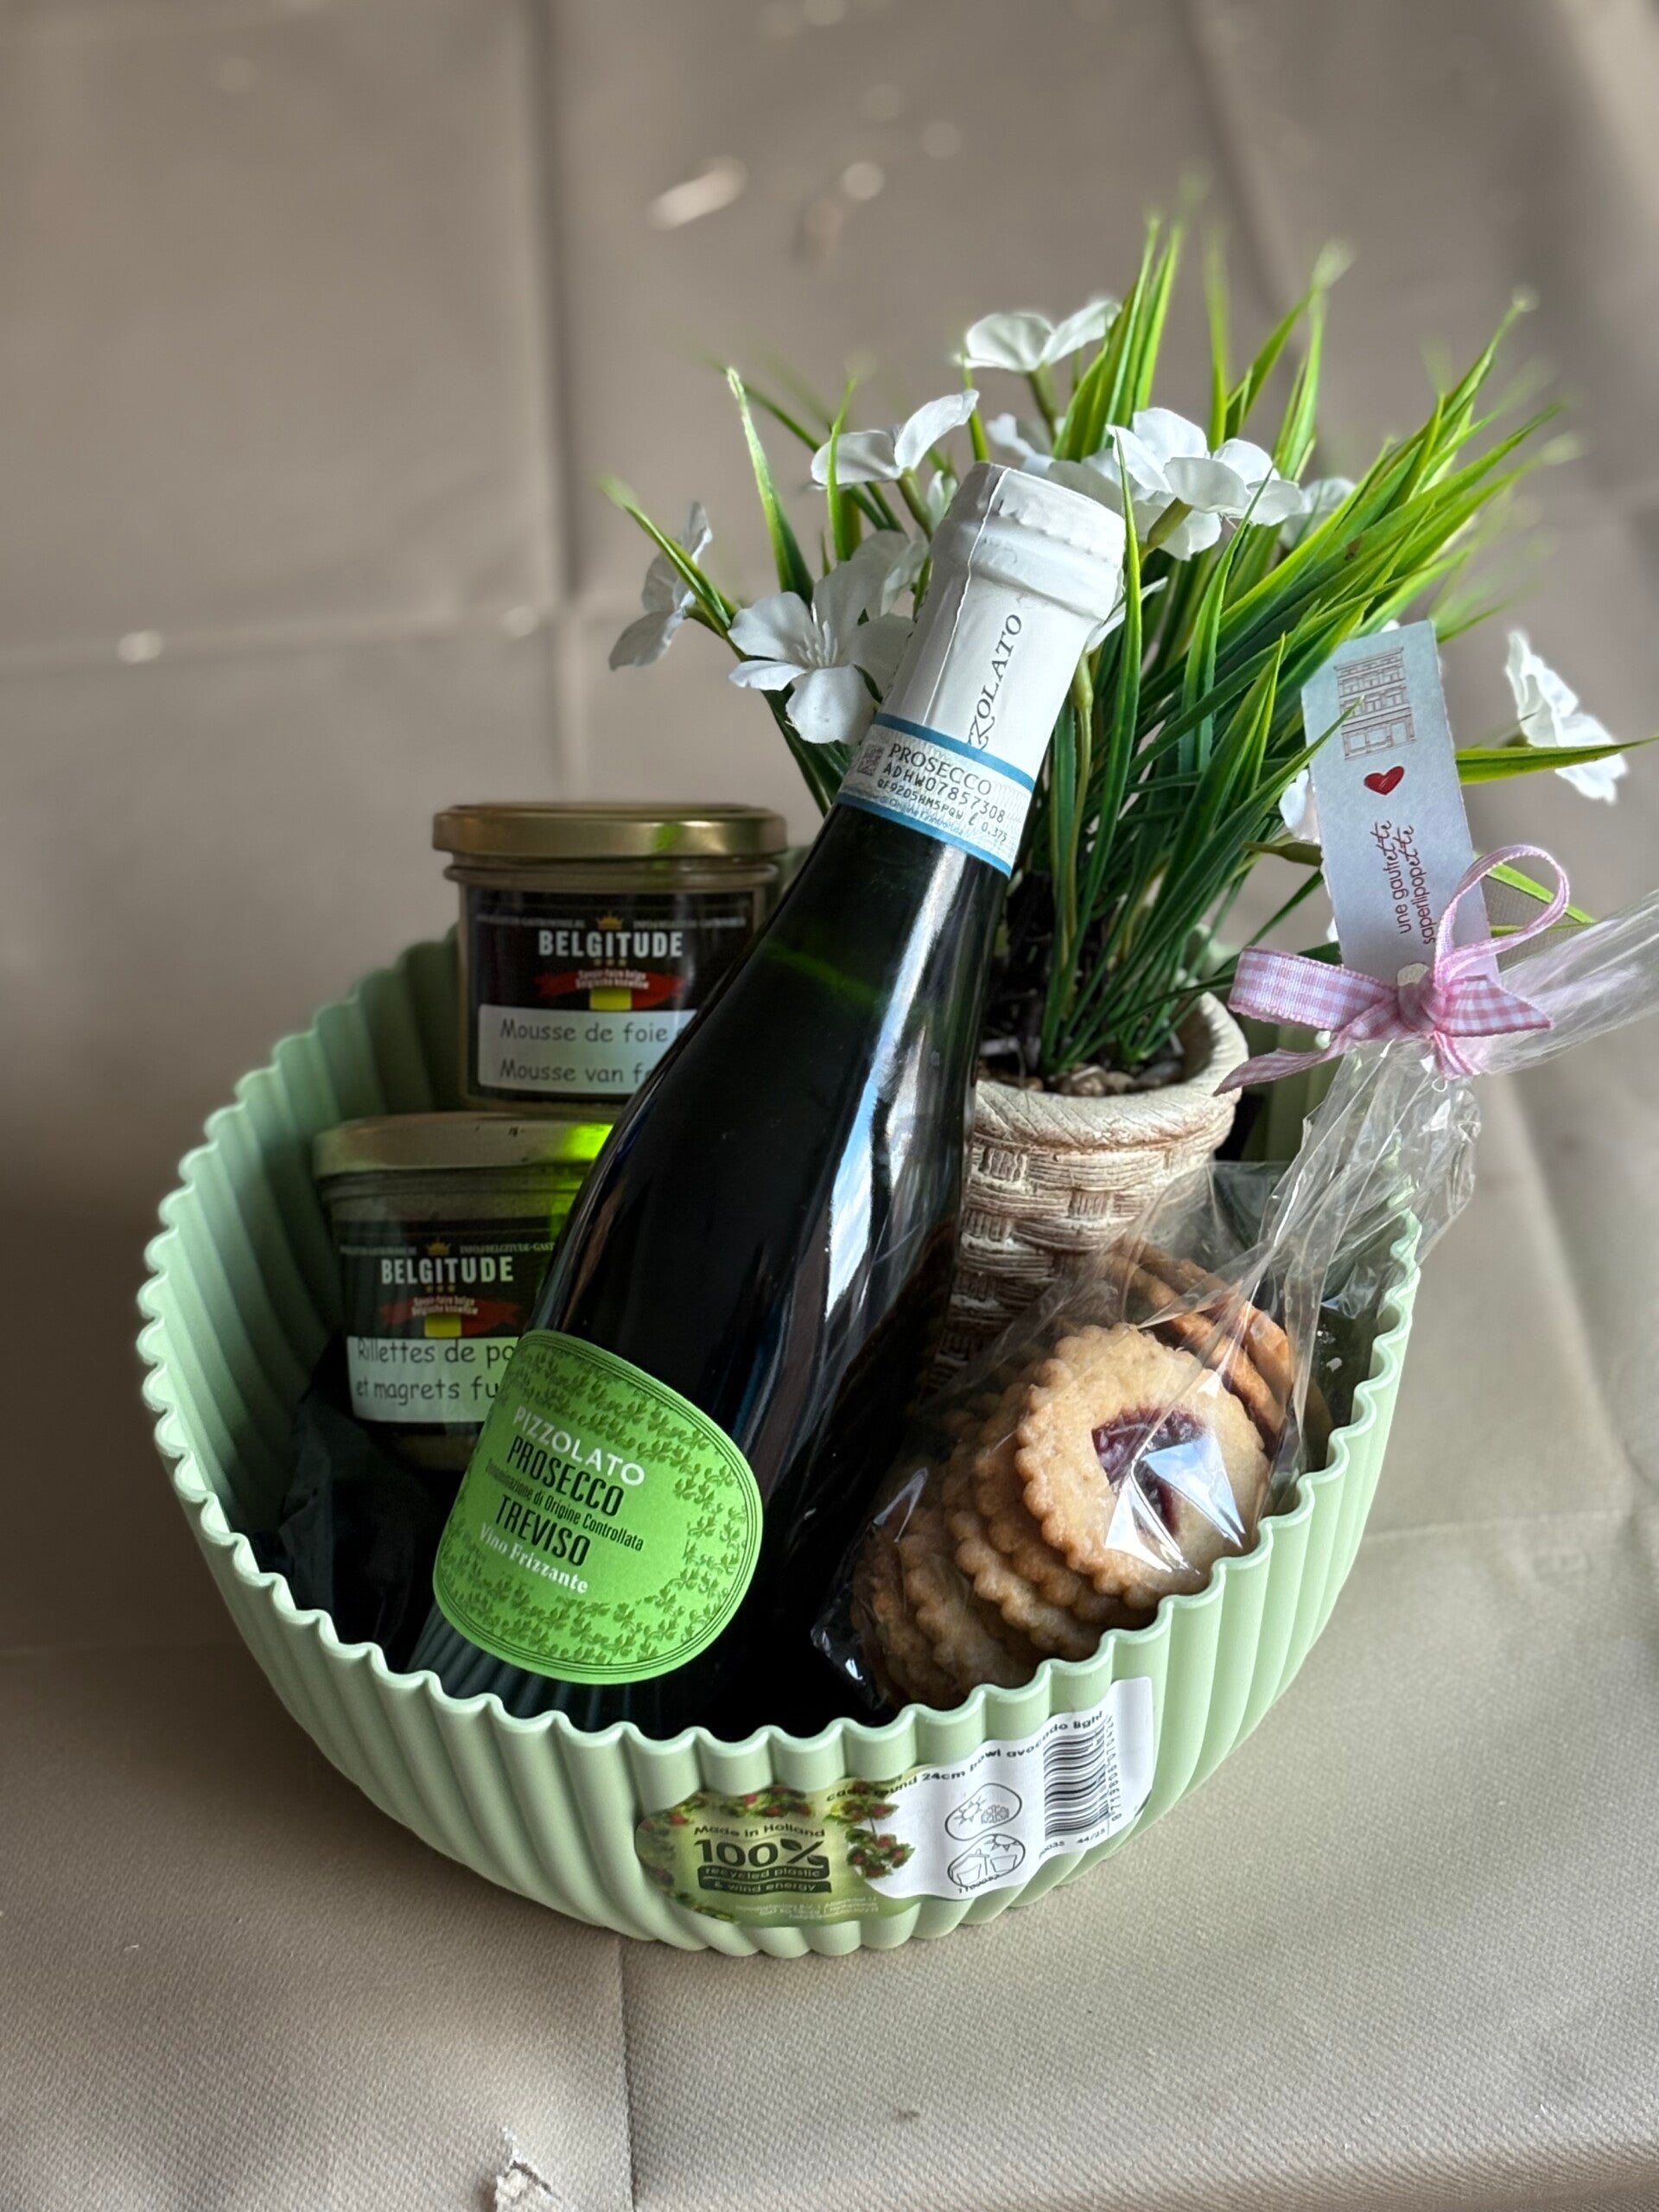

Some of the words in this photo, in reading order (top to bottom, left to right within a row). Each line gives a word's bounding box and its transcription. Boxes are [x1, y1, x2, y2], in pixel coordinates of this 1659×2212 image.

[888, 743, 992, 796] PROSECCO
[1370, 820, 1409, 899] gaufrette
[1393, 825, 1437, 944] saperlipopette
[1395, 904, 1412, 934] une
[538, 930, 683, 958] BELGITUDE
[500, 1018, 575, 1041] Mousse
[585, 1023, 613, 1043] de
[623, 1022, 667, 1043] foie
[499, 1058, 575, 1081] Mousse
[585, 1068, 624, 1083] van
[381, 1255, 513, 1284] BELGITUDE
[358, 1336, 435, 1363] Rillettes
[445, 1336, 475, 1363] de
[357, 1377, 369, 1397] et
[373, 1378, 460, 1406] magrets
[513, 1405, 645, 1486] PIZZOLATO
[507, 1434, 625, 1517] PROSECCO
[495, 1493, 591, 1567] TREVISO
[533, 1490, 543, 1507] di
[544, 1494, 582, 1524] Origine
[582, 1513, 644, 1552] Controllata
[480, 1522, 508, 1554] Vino
[510, 1542, 588, 1593] Frizzante
[922, 1770, 965, 1781] 24cm
[694, 1825, 740, 1837] Made
[764, 1823, 825, 1837] Holland
[694, 1838, 829, 1868] 100%
[705, 1866, 769, 1879] recycled
[774, 1866, 820, 1879] plastic
[728, 1881, 761, 1892] wind
[766, 1880, 817, 1892] energy
